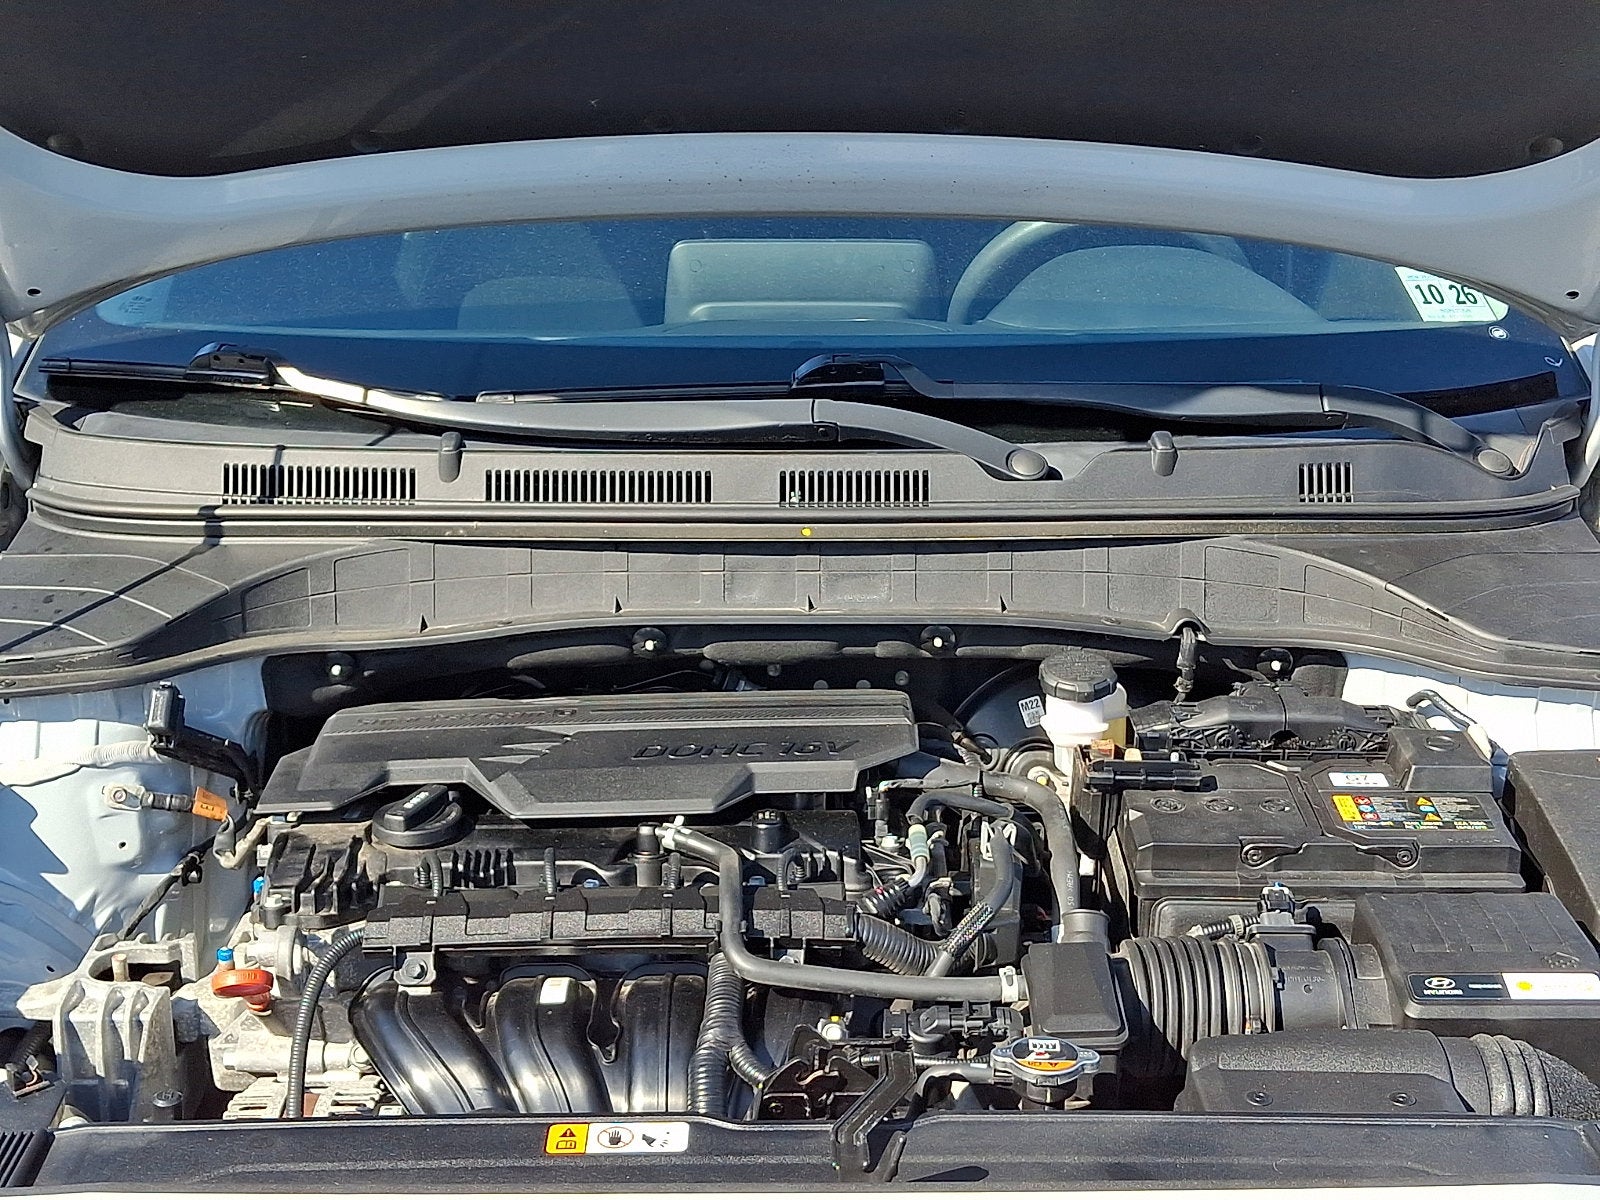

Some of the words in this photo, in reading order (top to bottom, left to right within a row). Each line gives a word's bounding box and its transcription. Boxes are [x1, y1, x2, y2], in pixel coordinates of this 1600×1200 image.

[1415, 284, 1445, 305] 10
[1448, 284, 1478, 305] 26
[1020, 698, 1041, 713] M22
[631, 742, 769, 760] DOHC
[778, 739, 860, 756] 16V
